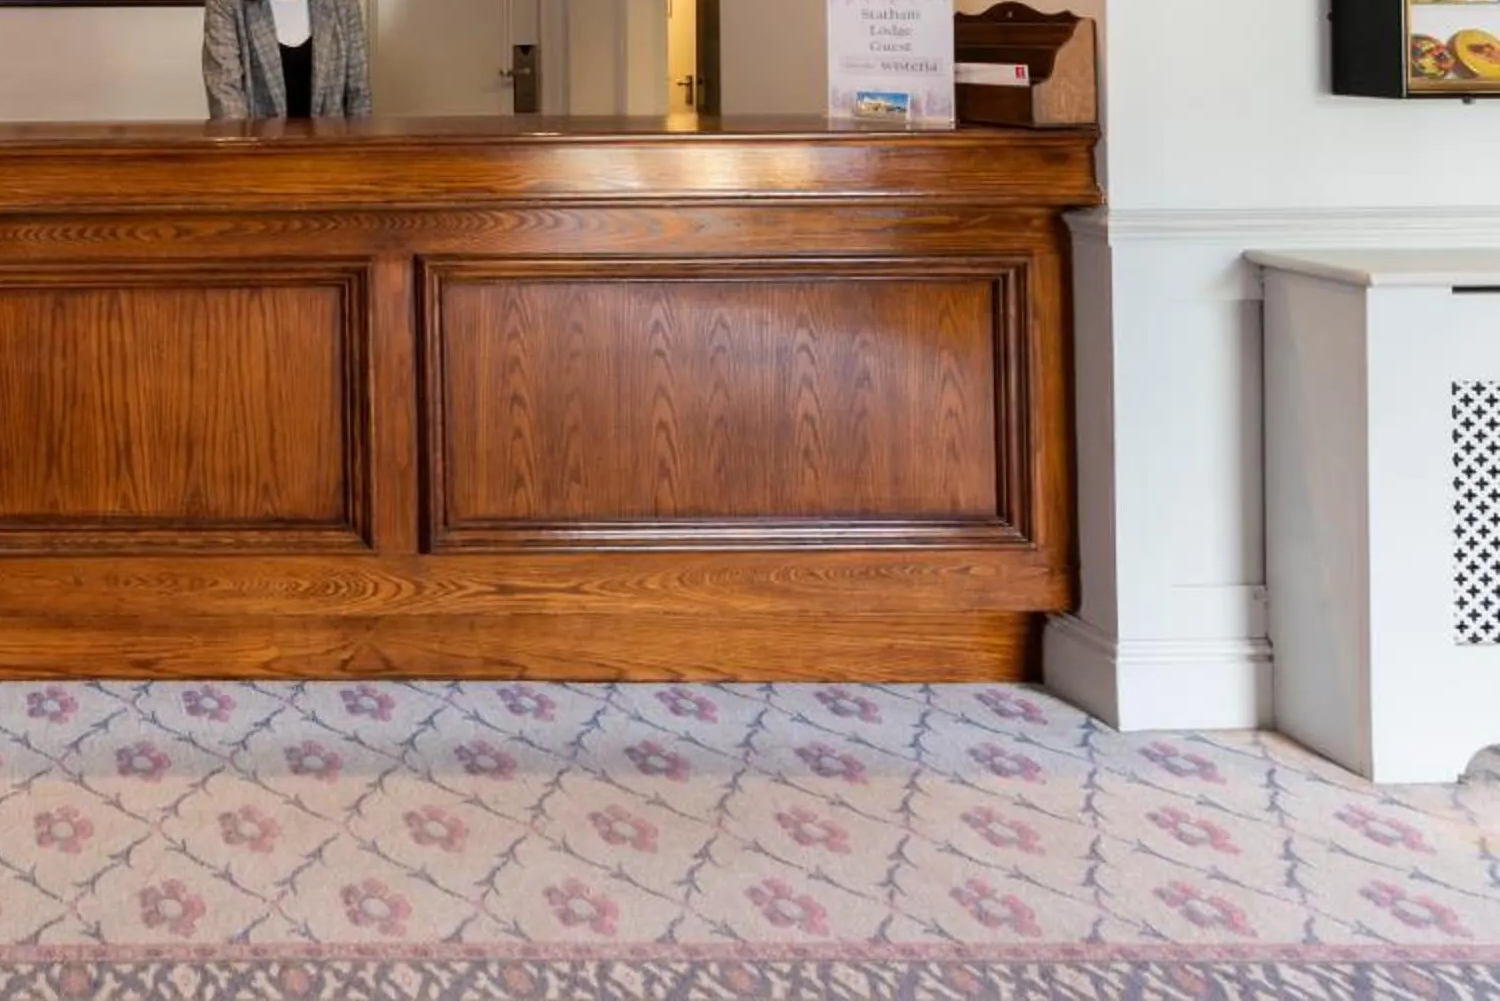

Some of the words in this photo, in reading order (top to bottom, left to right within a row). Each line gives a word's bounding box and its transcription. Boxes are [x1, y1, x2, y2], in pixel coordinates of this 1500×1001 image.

[860, 7, 920, 20] Statham
[869, 25, 913, 36] Lodge
[869, 42, 912, 52] Guest
